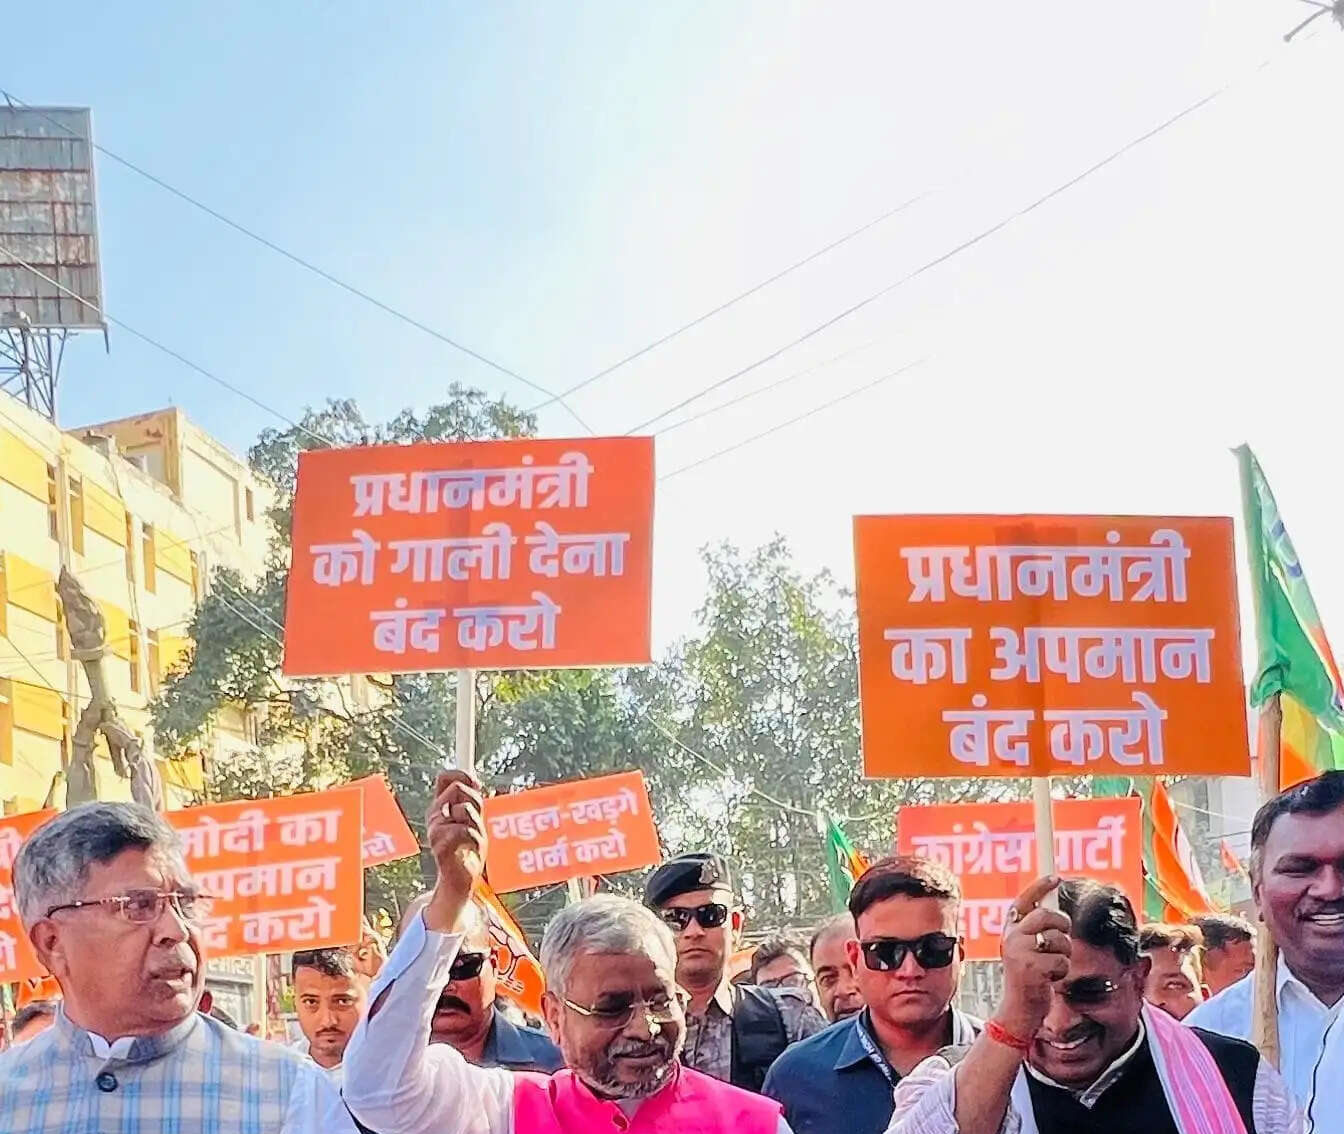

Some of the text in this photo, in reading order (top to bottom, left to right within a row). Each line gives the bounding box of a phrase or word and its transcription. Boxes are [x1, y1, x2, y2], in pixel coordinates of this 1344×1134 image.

[350, 451, 594, 517] प्रधानमंत्री
[309, 521, 631, 587] को गाली देना
[900, 529, 1191, 603] प्रधानमंत्री
[369, 591, 561, 654] बंद करो
[883, 627, 1215, 685] का अपमान
[942, 691, 1168, 767] बंद करो
[275, 809, 343, 845] का
[518, 831, 627, 874] शर्म करो
[910, 821, 1035, 875] कांग्रेस
[193, 856, 342, 901] पमान
[239, 896, 336, 945] करो
